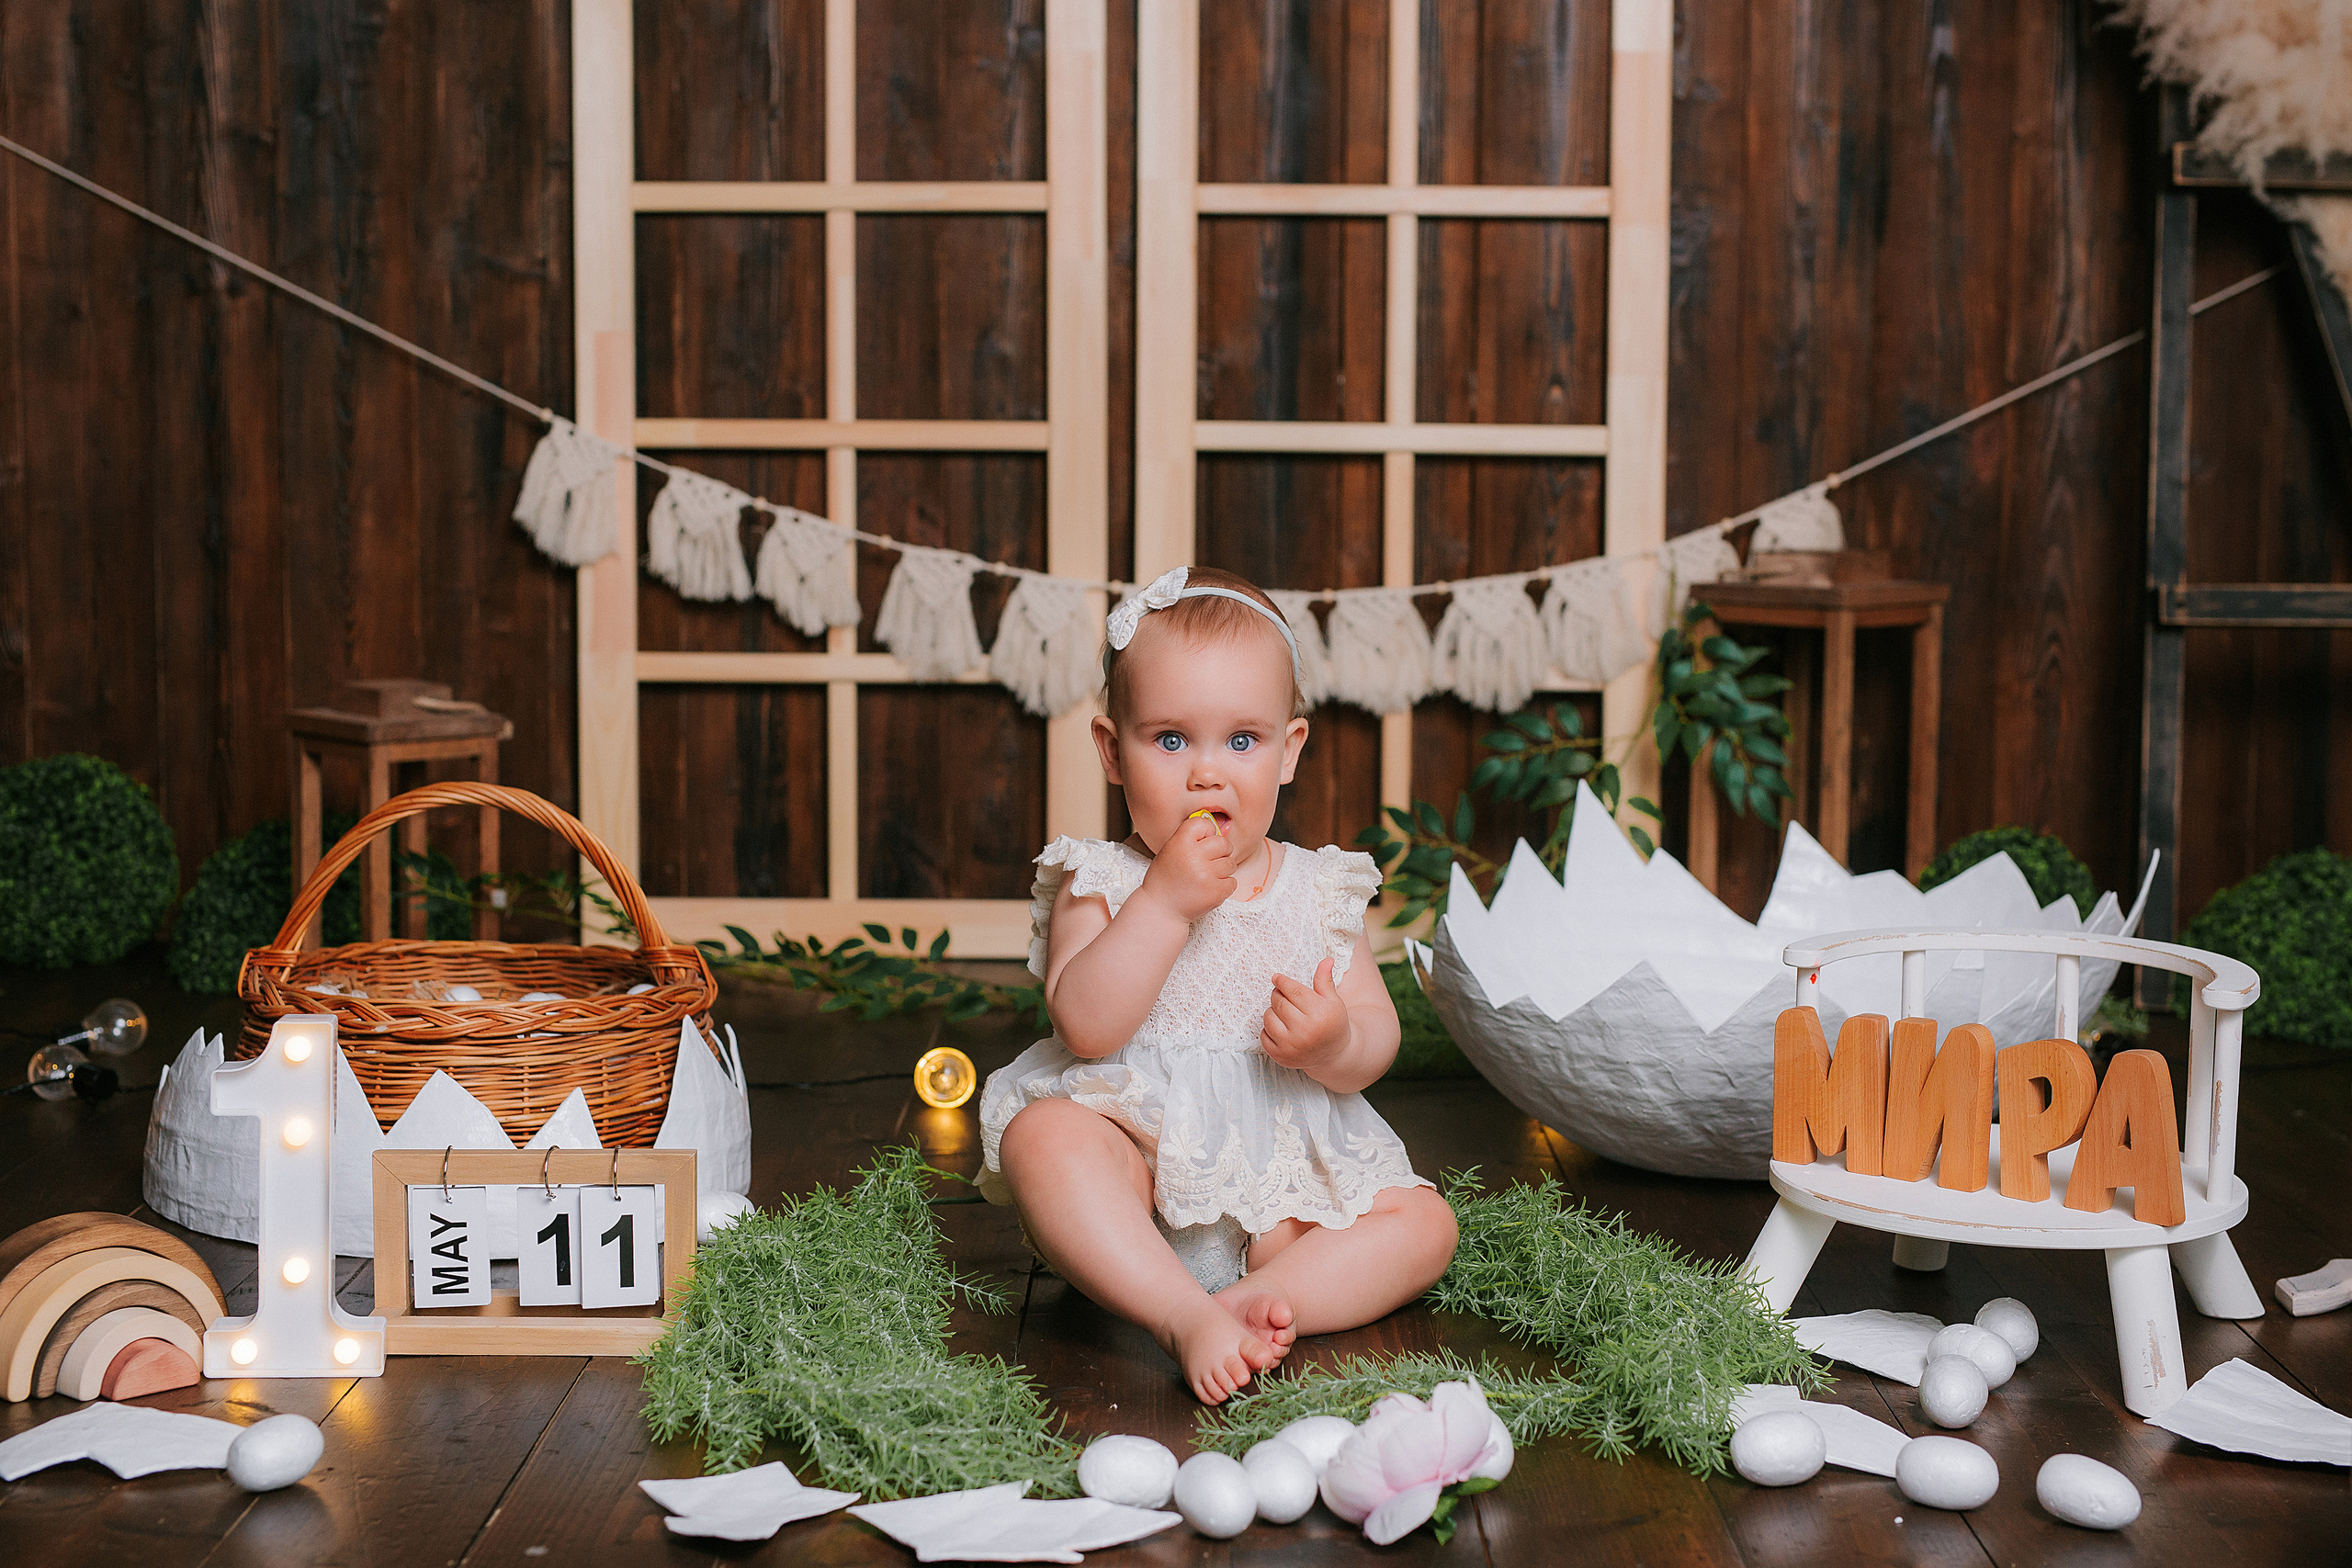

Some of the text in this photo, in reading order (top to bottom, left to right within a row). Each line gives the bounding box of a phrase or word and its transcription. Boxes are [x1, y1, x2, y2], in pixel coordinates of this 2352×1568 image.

[204, 1014, 387, 1378] 1
[1773, 1007, 2186, 1226] МИРА
[430, 1213, 469, 1295] MAY
